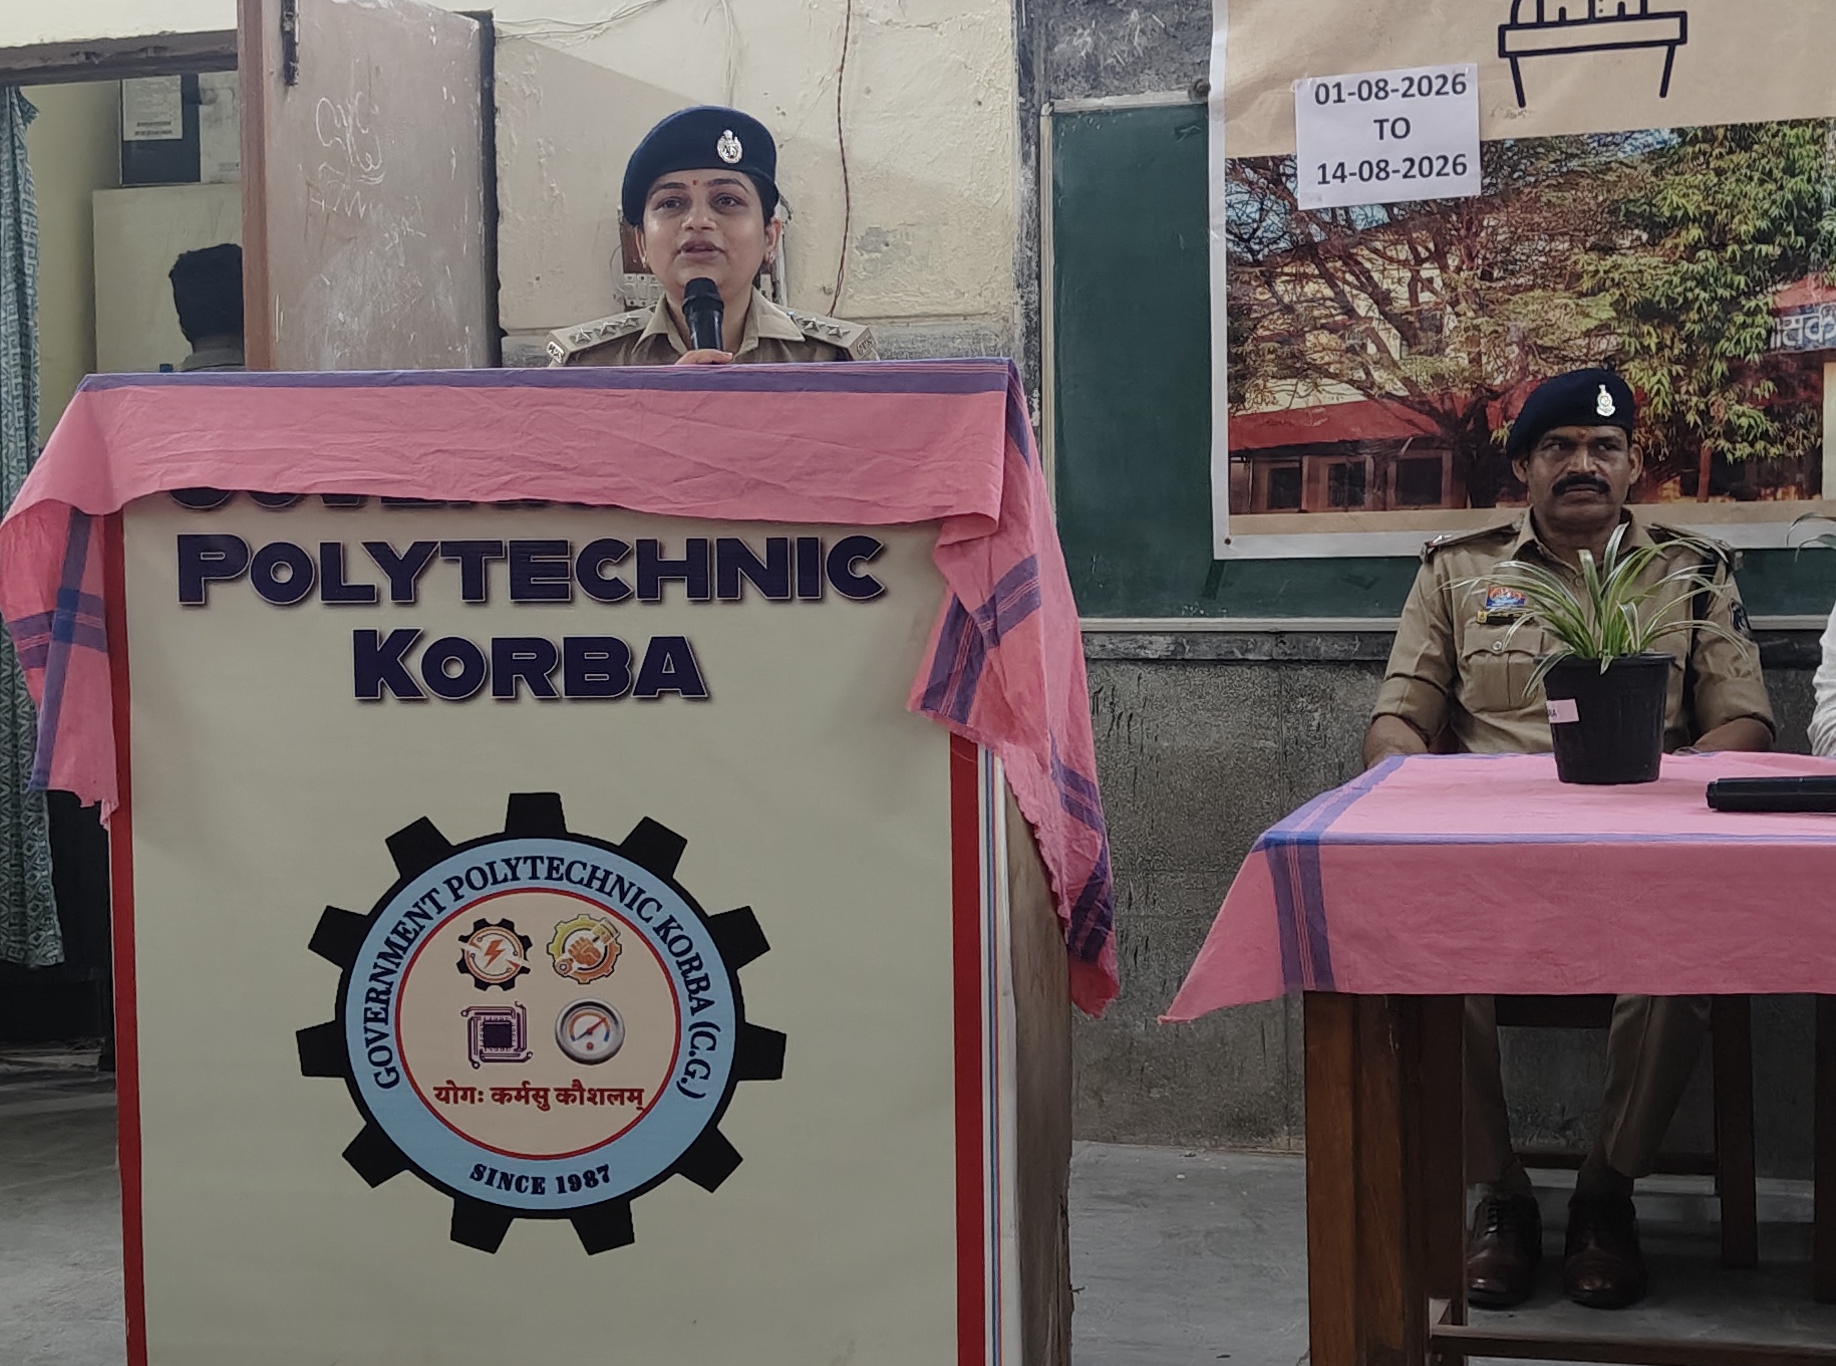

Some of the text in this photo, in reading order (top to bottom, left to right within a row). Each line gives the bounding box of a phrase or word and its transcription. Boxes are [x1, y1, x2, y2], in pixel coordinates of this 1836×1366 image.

[1314, 73, 1468, 106] 01-08-2026
[1373, 117, 1412, 140] TO
[1317, 153, 1468, 186] 14-08-2026
[175, 533, 888, 607] POLYTECHNIC
[352, 627, 710, 703] KORBA
[364, 855, 722, 1099] GOVERNMENT POLYTECHNIC KORBA (C.G.)
[490, 1080, 551, 1112] कर्मसु
[553, 1078, 645, 1111] कौशलम्
[469, 1162, 612, 1195] SINCE 1987
